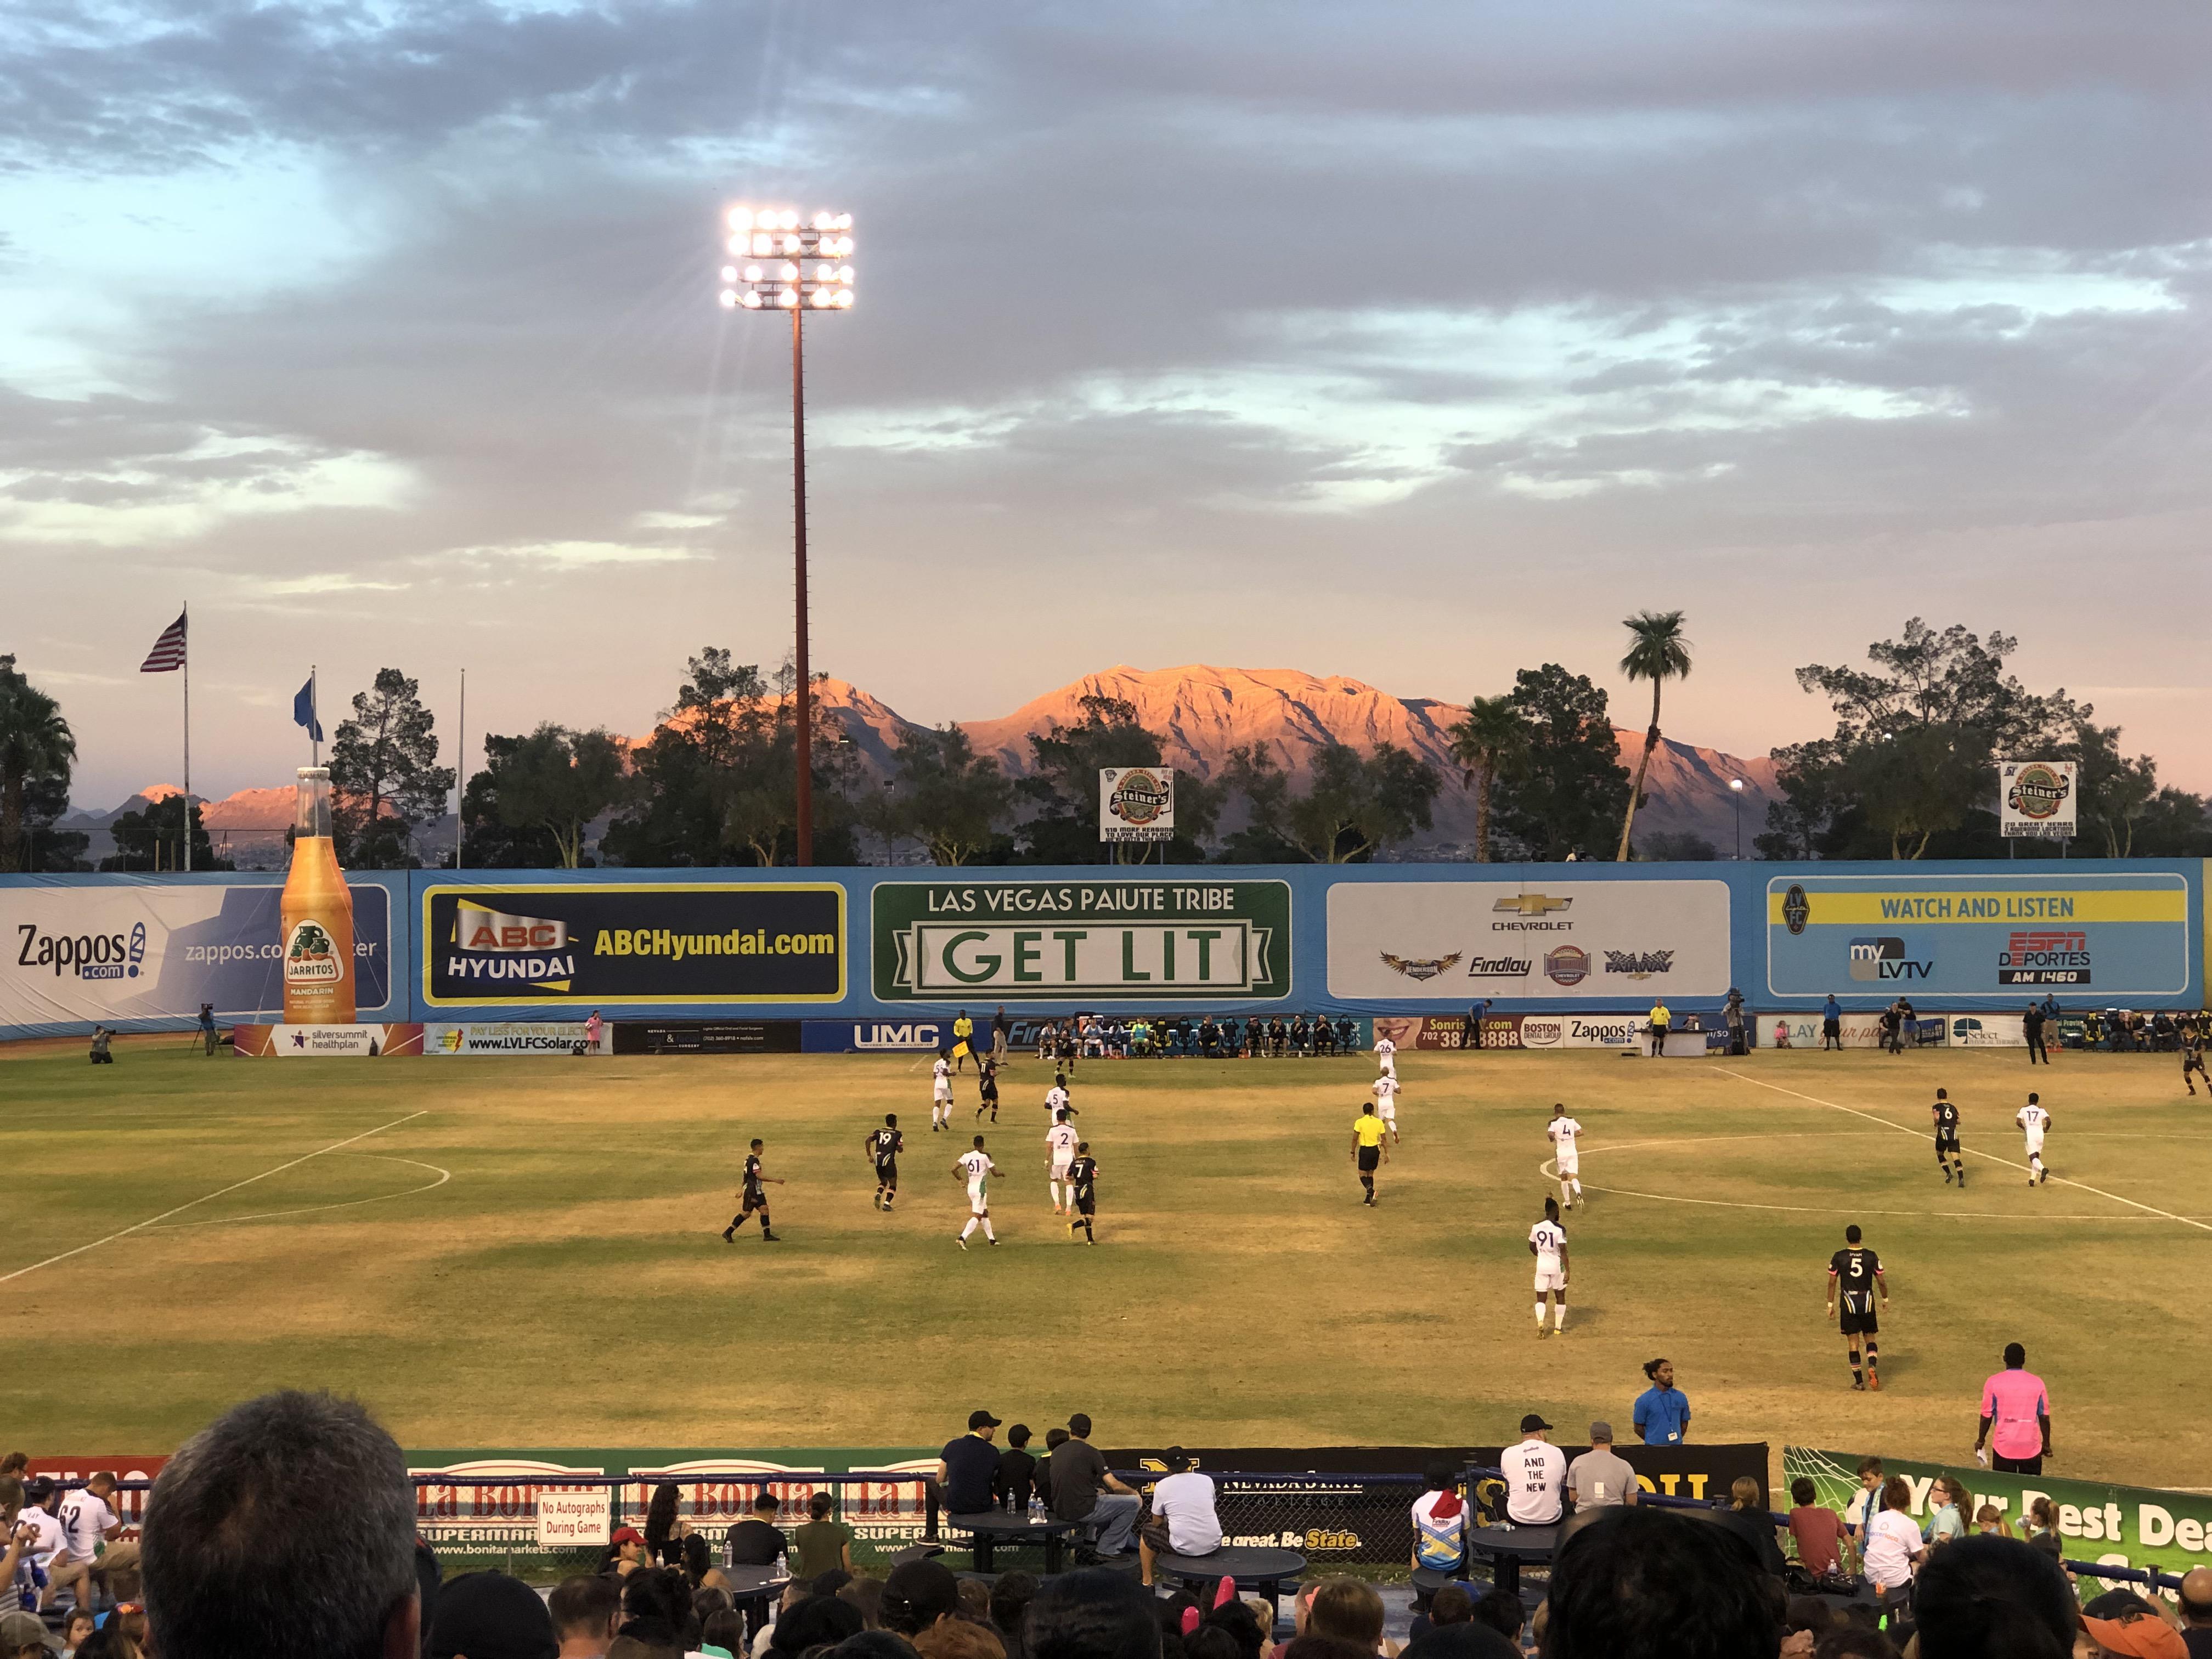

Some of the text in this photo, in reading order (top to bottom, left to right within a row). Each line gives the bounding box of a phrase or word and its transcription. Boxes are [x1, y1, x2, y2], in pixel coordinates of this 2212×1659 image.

[1113, 791, 1167, 804] Steiner's
[2012, 786, 2067, 798] Steiner's
[928, 887, 1234, 912] LAS VEGAS PAIUTE TRIBE
[1790, 893, 1802, 906] LV
[1880, 896, 2074, 919] WATCH AND LISTEN
[1790, 911, 1802, 925] FC
[1492, 921, 1574, 931] CHEVROLET
[469, 924, 556, 947] ABC
[2008, 932, 2086, 951] ESPN
[18, 924, 126, 977] Zappos
[594, 928, 835, 961] ABCHyundai.com
[941, 930, 1222, 983] GET LIT
[1850, 943, 1884, 964] my
[1999, 951, 2091, 967] DEPORTES
[83, 965, 122, 979] .com
[289, 964, 334, 976] JARRITOS
[447, 955, 575, 979] HYUNDAI
[1406, 965, 1438, 974] HENDERSON
[1469, 956, 1532, 977] Findlay
[1605, 961, 1673, 973] FAIRWAY
[1878, 961, 1933, 979] LVTV
[2011, 971, 2078, 983] AM 1460
[290, 988, 334, 996] MANDARIN
[312, 1030, 368, 1039] silversummit
[470, 1026, 487, 1036] PAY
[488, 1026, 510, 1036] LESS
[512, 1026, 529, 1036] FOR
[530, 1026, 556, 1036] YOUR
[1523, 1023, 1561, 1032] BOSTON
[1571, 1020, 1626, 1042] Zappos
[1786, 1024, 1817, 1038] LAY
[1968, 1029, 1998, 1039] Select
[667, 1034, 674, 1042] &
[854, 1024, 939, 1048] UMC
[1422, 1032, 1438, 1041] 702
[312, 1040, 359, 1050] healthplan
[1380, 1044, 1391, 1053] 26
[981, 1063, 986, 1073] 11
[1382, 1082, 1390, 1093] 7
[1053, 1094, 1058, 1104] 5
[1944, 1108, 1953, 1119] 6
[2026, 1110, 2039, 1122] 17
[1562, 1124, 1571, 1136] 4
[879, 1132, 892, 1146] 19
[1060, 1132, 1069, 1145] 2
[967, 1159, 980, 1173] 61
[1075, 1164, 1084, 1178] 7
[1537, 1230, 1554, 1248] 91
[1849, 1257, 1863, 1277] 5
[1524, 1457, 1545, 1468] AND
[1527, 1470, 1544, 1480] THE
[1526, 1482, 1546, 1492] NEW
[416, 1485, 458, 1519] La
[857, 1482, 900, 1518] La
[542, 1500, 605, 1515] No Autographs
[59, 1505, 81, 1533] 62
[546, 1521, 601, 1537] During Game
[1280, 1532, 1304, 1548] Be
[1305, 1528, 1363, 1550] State.
